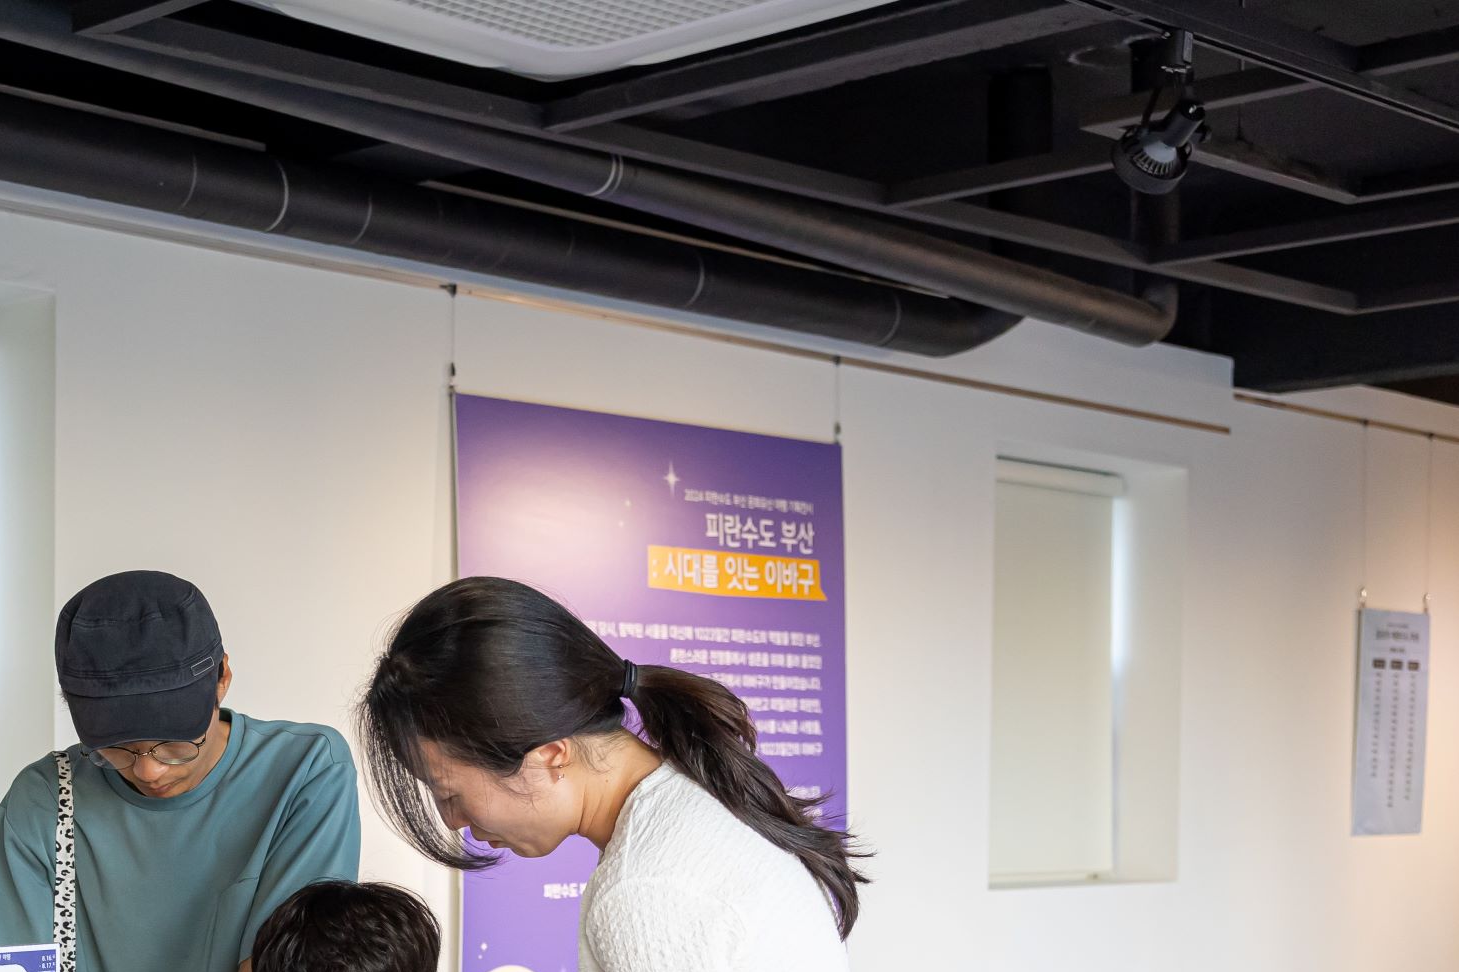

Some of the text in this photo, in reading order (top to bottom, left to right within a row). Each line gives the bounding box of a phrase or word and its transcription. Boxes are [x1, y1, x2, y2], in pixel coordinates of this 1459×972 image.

[705, 513, 814, 554] 피란수도 부산
[664, 552, 815, 595] 시대를 잇는 이바구
